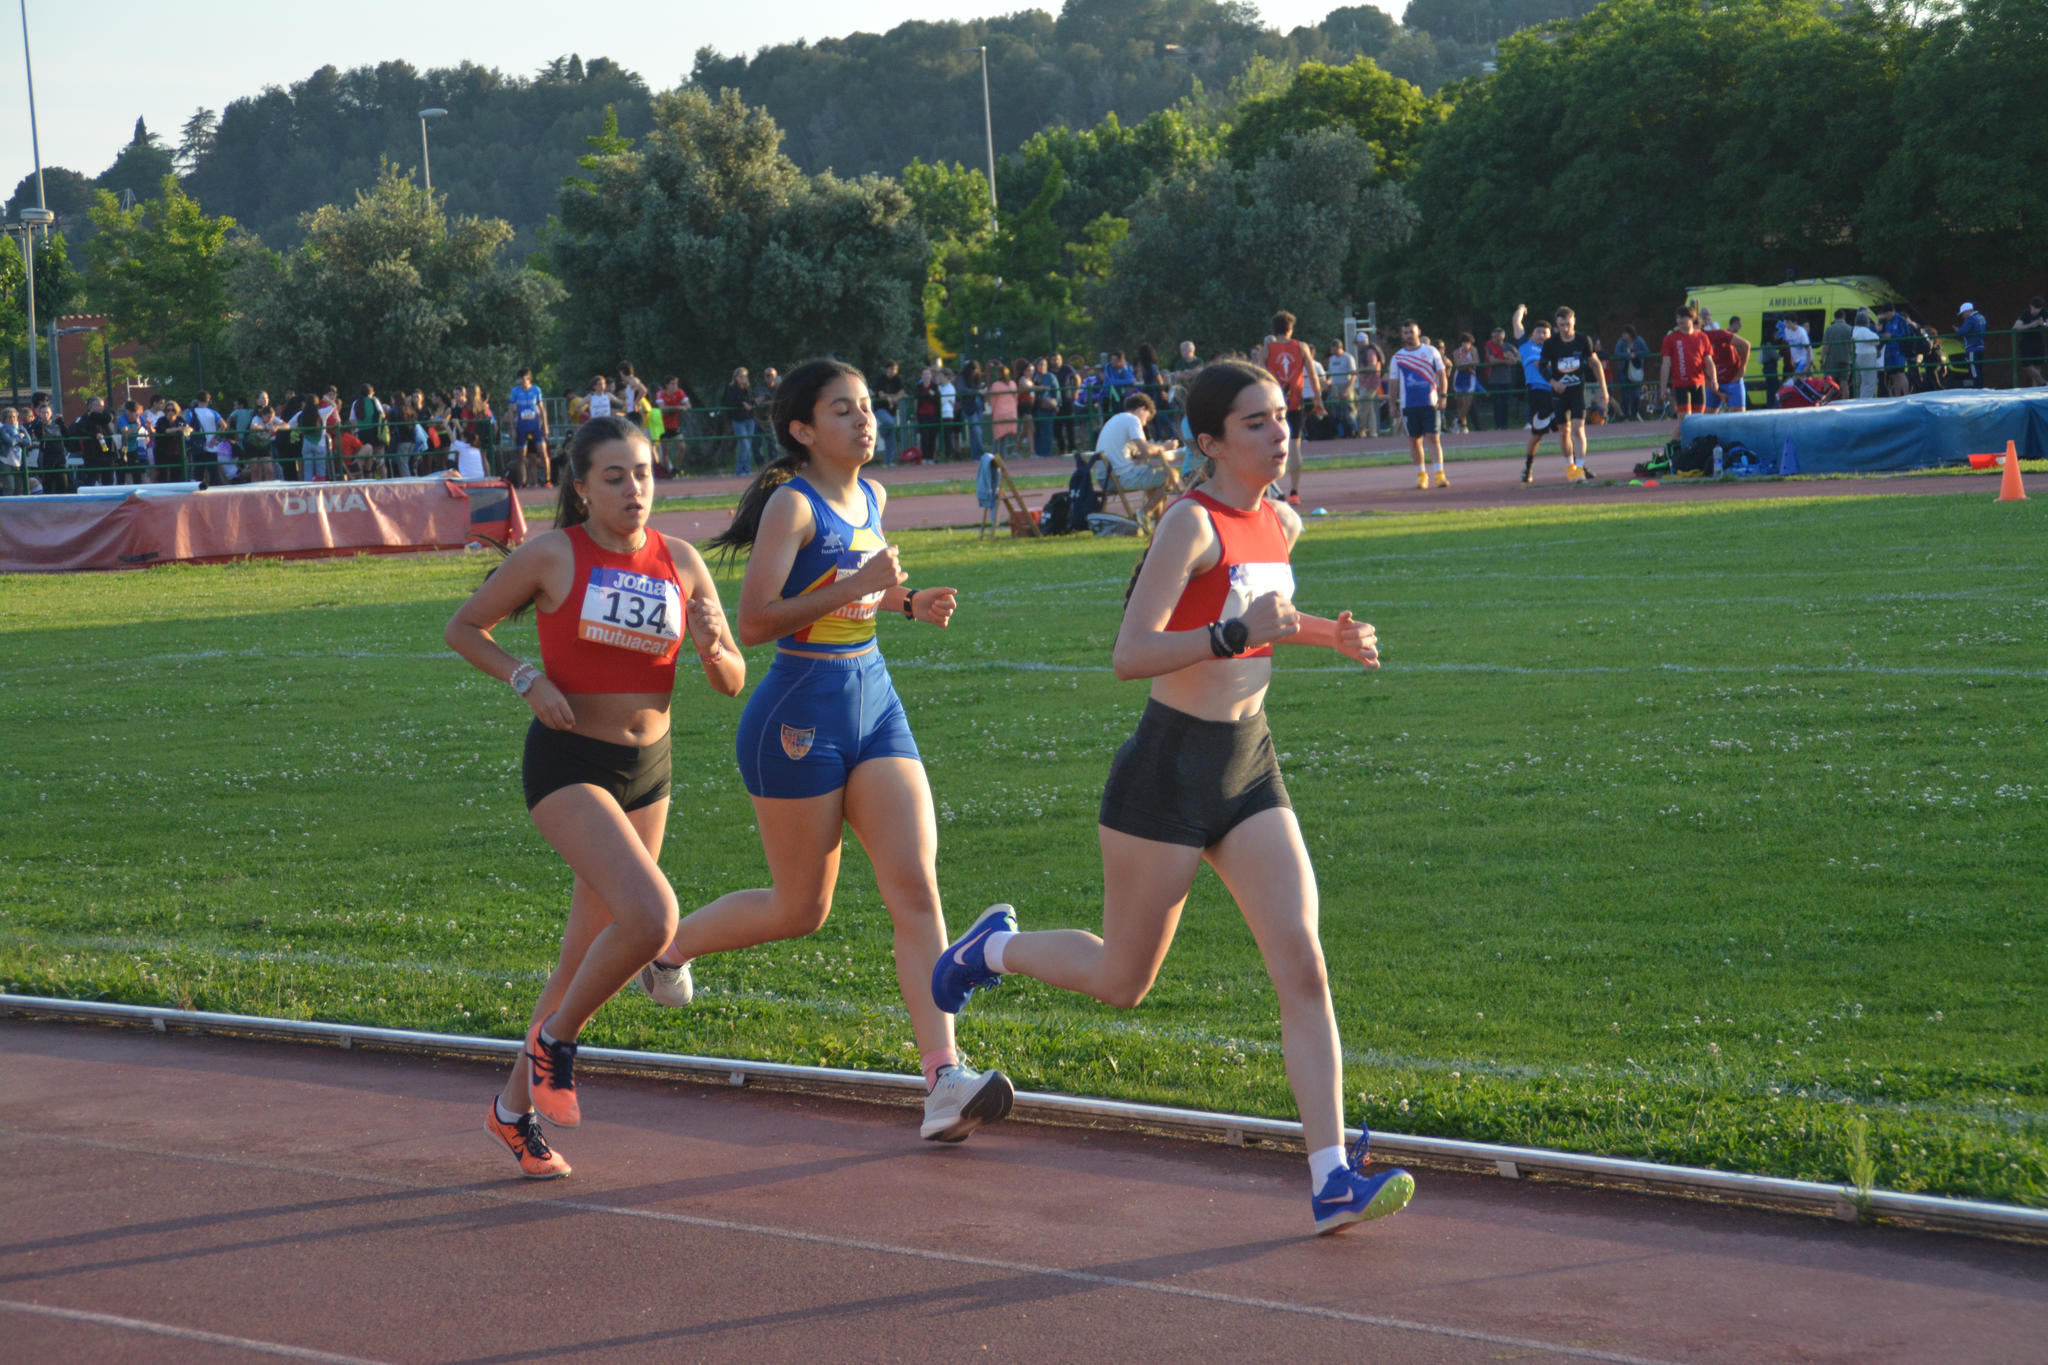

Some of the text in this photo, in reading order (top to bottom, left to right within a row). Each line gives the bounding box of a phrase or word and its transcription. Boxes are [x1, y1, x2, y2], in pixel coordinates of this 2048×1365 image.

[282, 493, 370, 516] DIMA
[602, 591, 667, 635] 134
[585, 625, 669, 656] mutuacat
